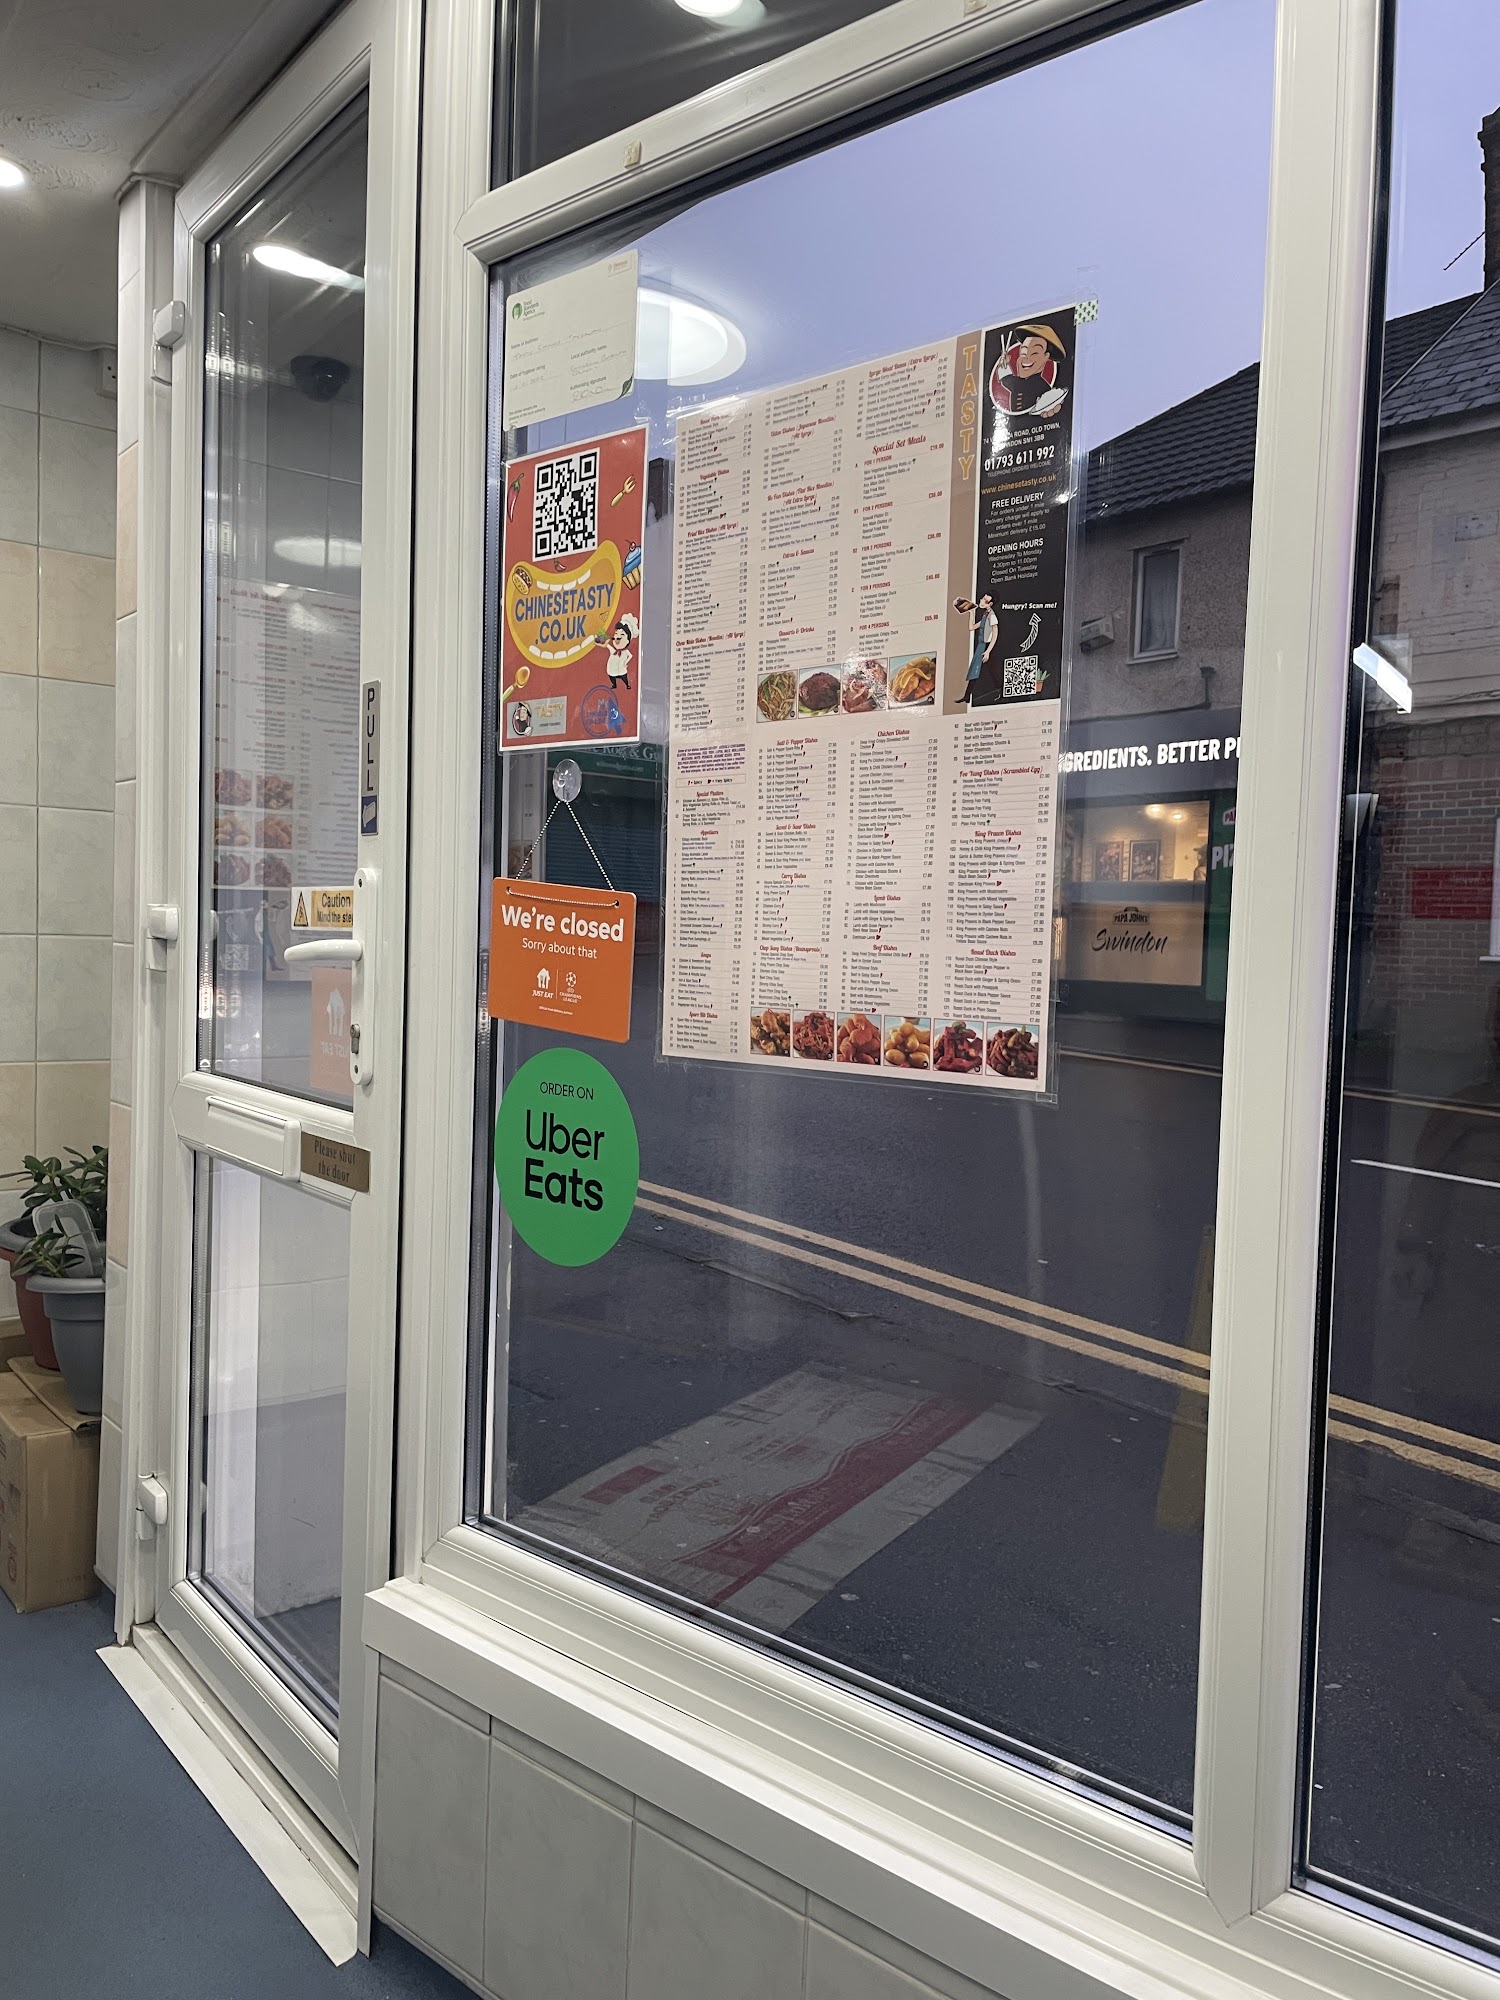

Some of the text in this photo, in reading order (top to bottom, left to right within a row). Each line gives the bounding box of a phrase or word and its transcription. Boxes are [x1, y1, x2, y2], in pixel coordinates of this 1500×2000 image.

[959, 344, 977, 480] TASTY
[1032, 425, 1042, 433] OLD
[872, 435, 926, 455] Special Set Meals
[985, 445, 1055, 471] 01793 611 992
[981, 474, 1056, 495] www.chinesetasty.co.uk
[875, 502, 893, 510] PERSONS
[992, 492, 1044, 509] FREE DELIVERY
[1005, 514, 1021, 522] charge
[988, 524, 1046, 539] Minimum delivery £15.00
[988, 538, 1044, 555] OPENING HOURS
[988, 553, 1016, 562] Wednesday
[1023, 549, 1042, 557] Monday
[992, 568, 1008, 576] Closed
[1018, 564, 1038, 572] Tuesday
[993, 561, 1010, 569] 4.30pm
[515, 583, 614, 622] CHINESETASTY
[1002, 603, 1027, 611] Hungry?
[535, 615, 586, 645] .CO.UK
[535, 703, 564, 717] TASTY
[366, 687, 375, 791] PULL
[1157, 739, 1220, 765] BETTER
[1001, 767, 1030, 776] (Scrambled
[1031, 766, 1043, 774] Egg)
[322, 893, 350, 908] Caution
[317, 908, 330, 922] Mind
[332, 911, 341, 922] the
[502, 904, 624, 942] We're closed
[1114, 913, 1128, 922] PAPA
[522, 938, 597, 959] Sorry about that
[1092, 929, 1168, 954] Swindon
[540, 1082, 594, 1100] ORDER ON
[526, 1110, 605, 1160] Uber
[315, 1140, 355, 1165] Please shut
[319, 1161, 349, 1182] the door
[525, 1158, 603, 1212] Eats
